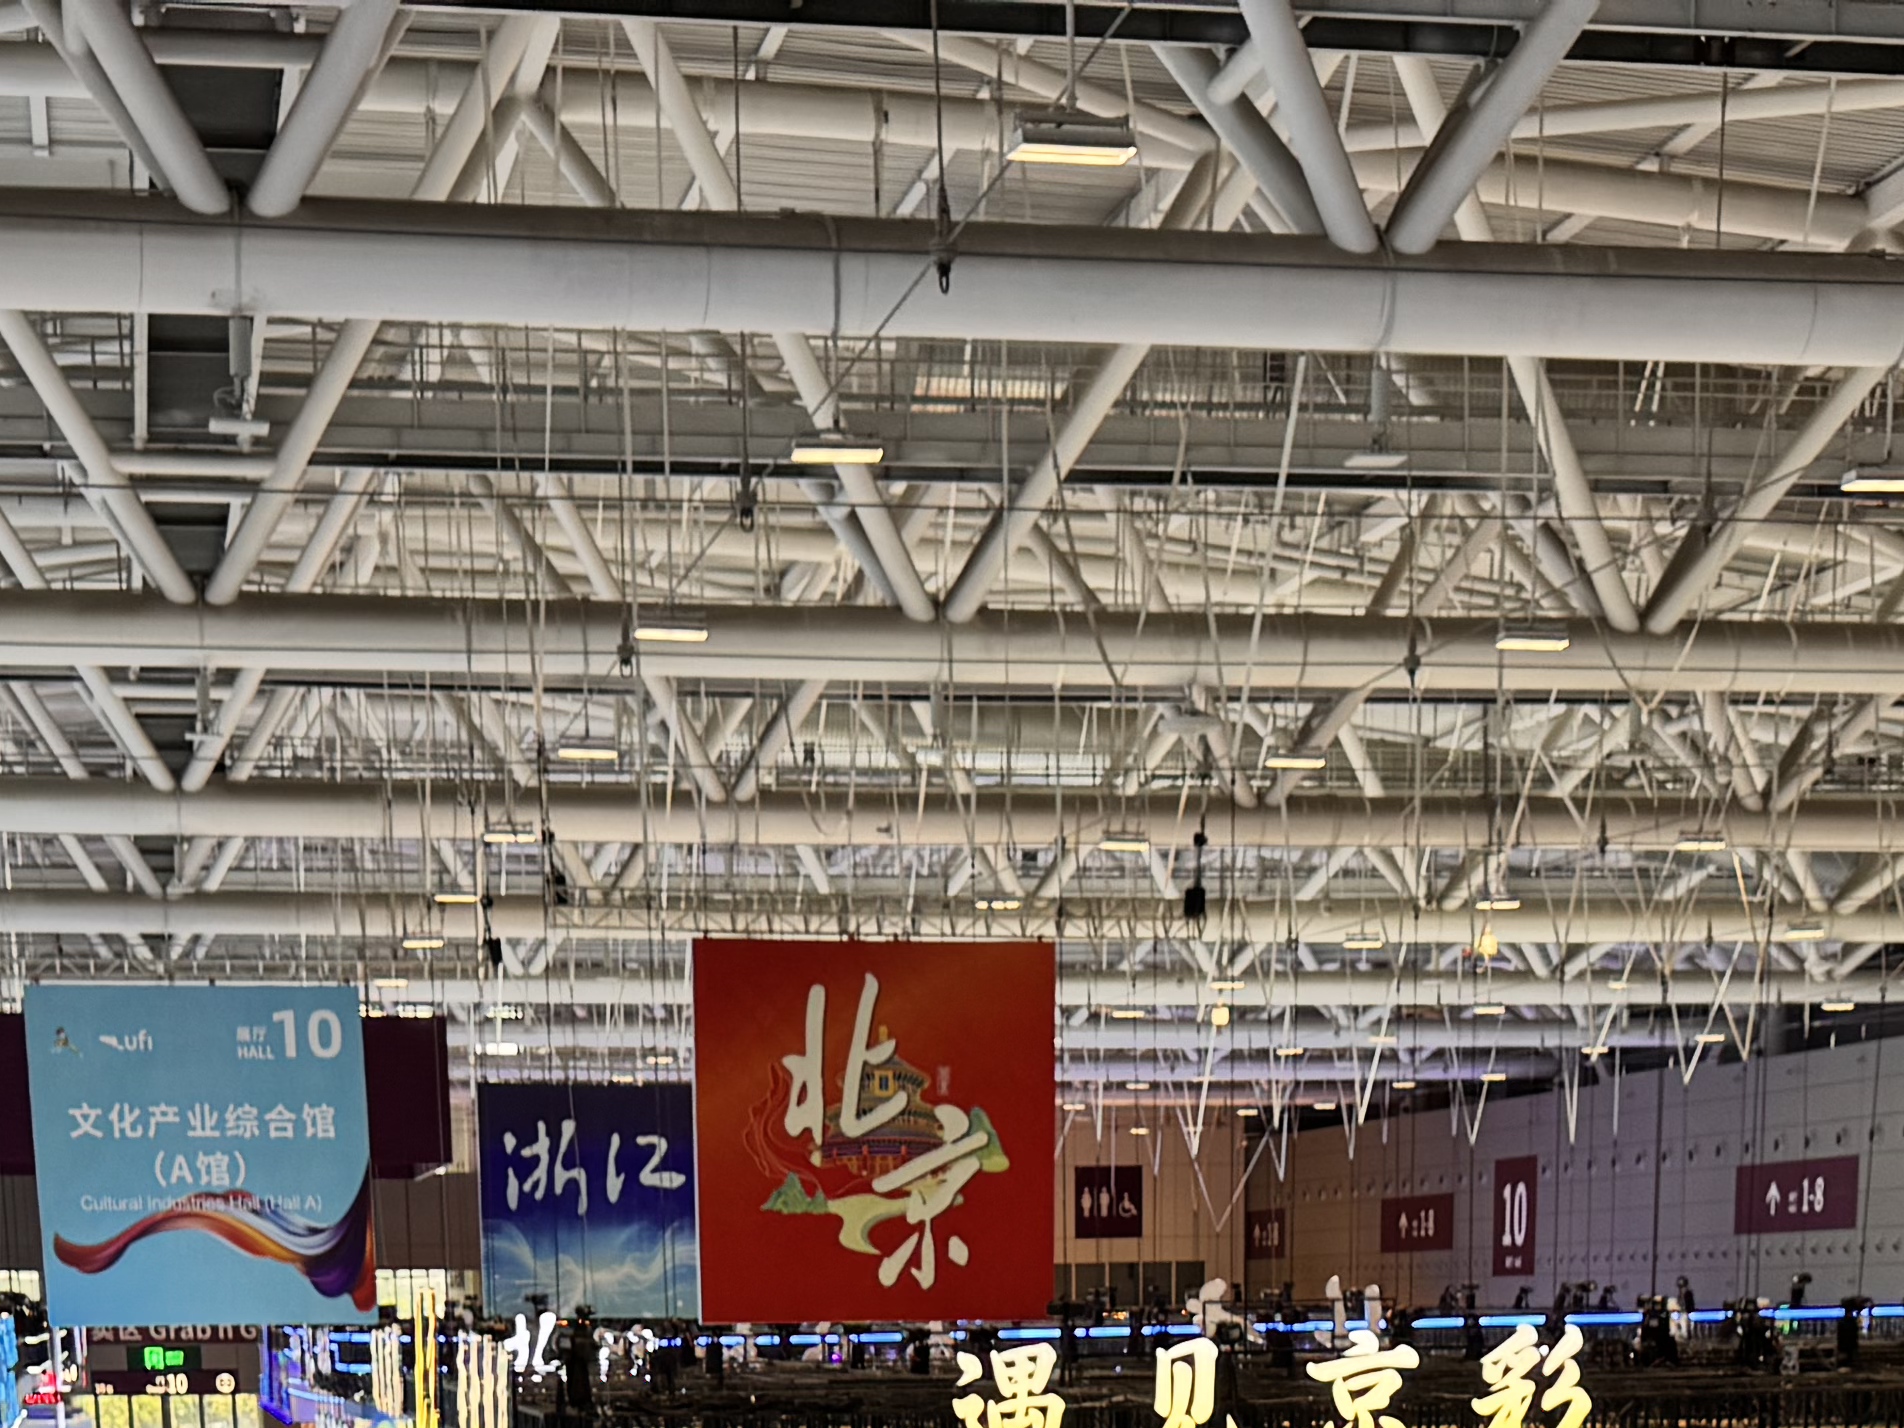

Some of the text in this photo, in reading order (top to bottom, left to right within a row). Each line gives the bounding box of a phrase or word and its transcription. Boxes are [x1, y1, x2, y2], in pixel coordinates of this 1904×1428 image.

[238, 1045, 275, 1060] HALL
[272, 1009, 342, 1059] 10
[68, 1102, 336, 1140] 文化产业综合馆
[503, 1119, 686, 1214] 浙江
[80, 1195, 144, 1212] Cultural
[1501, 1180, 1528, 1248] 10
[1802, 1176, 1826, 1214] 1-8
